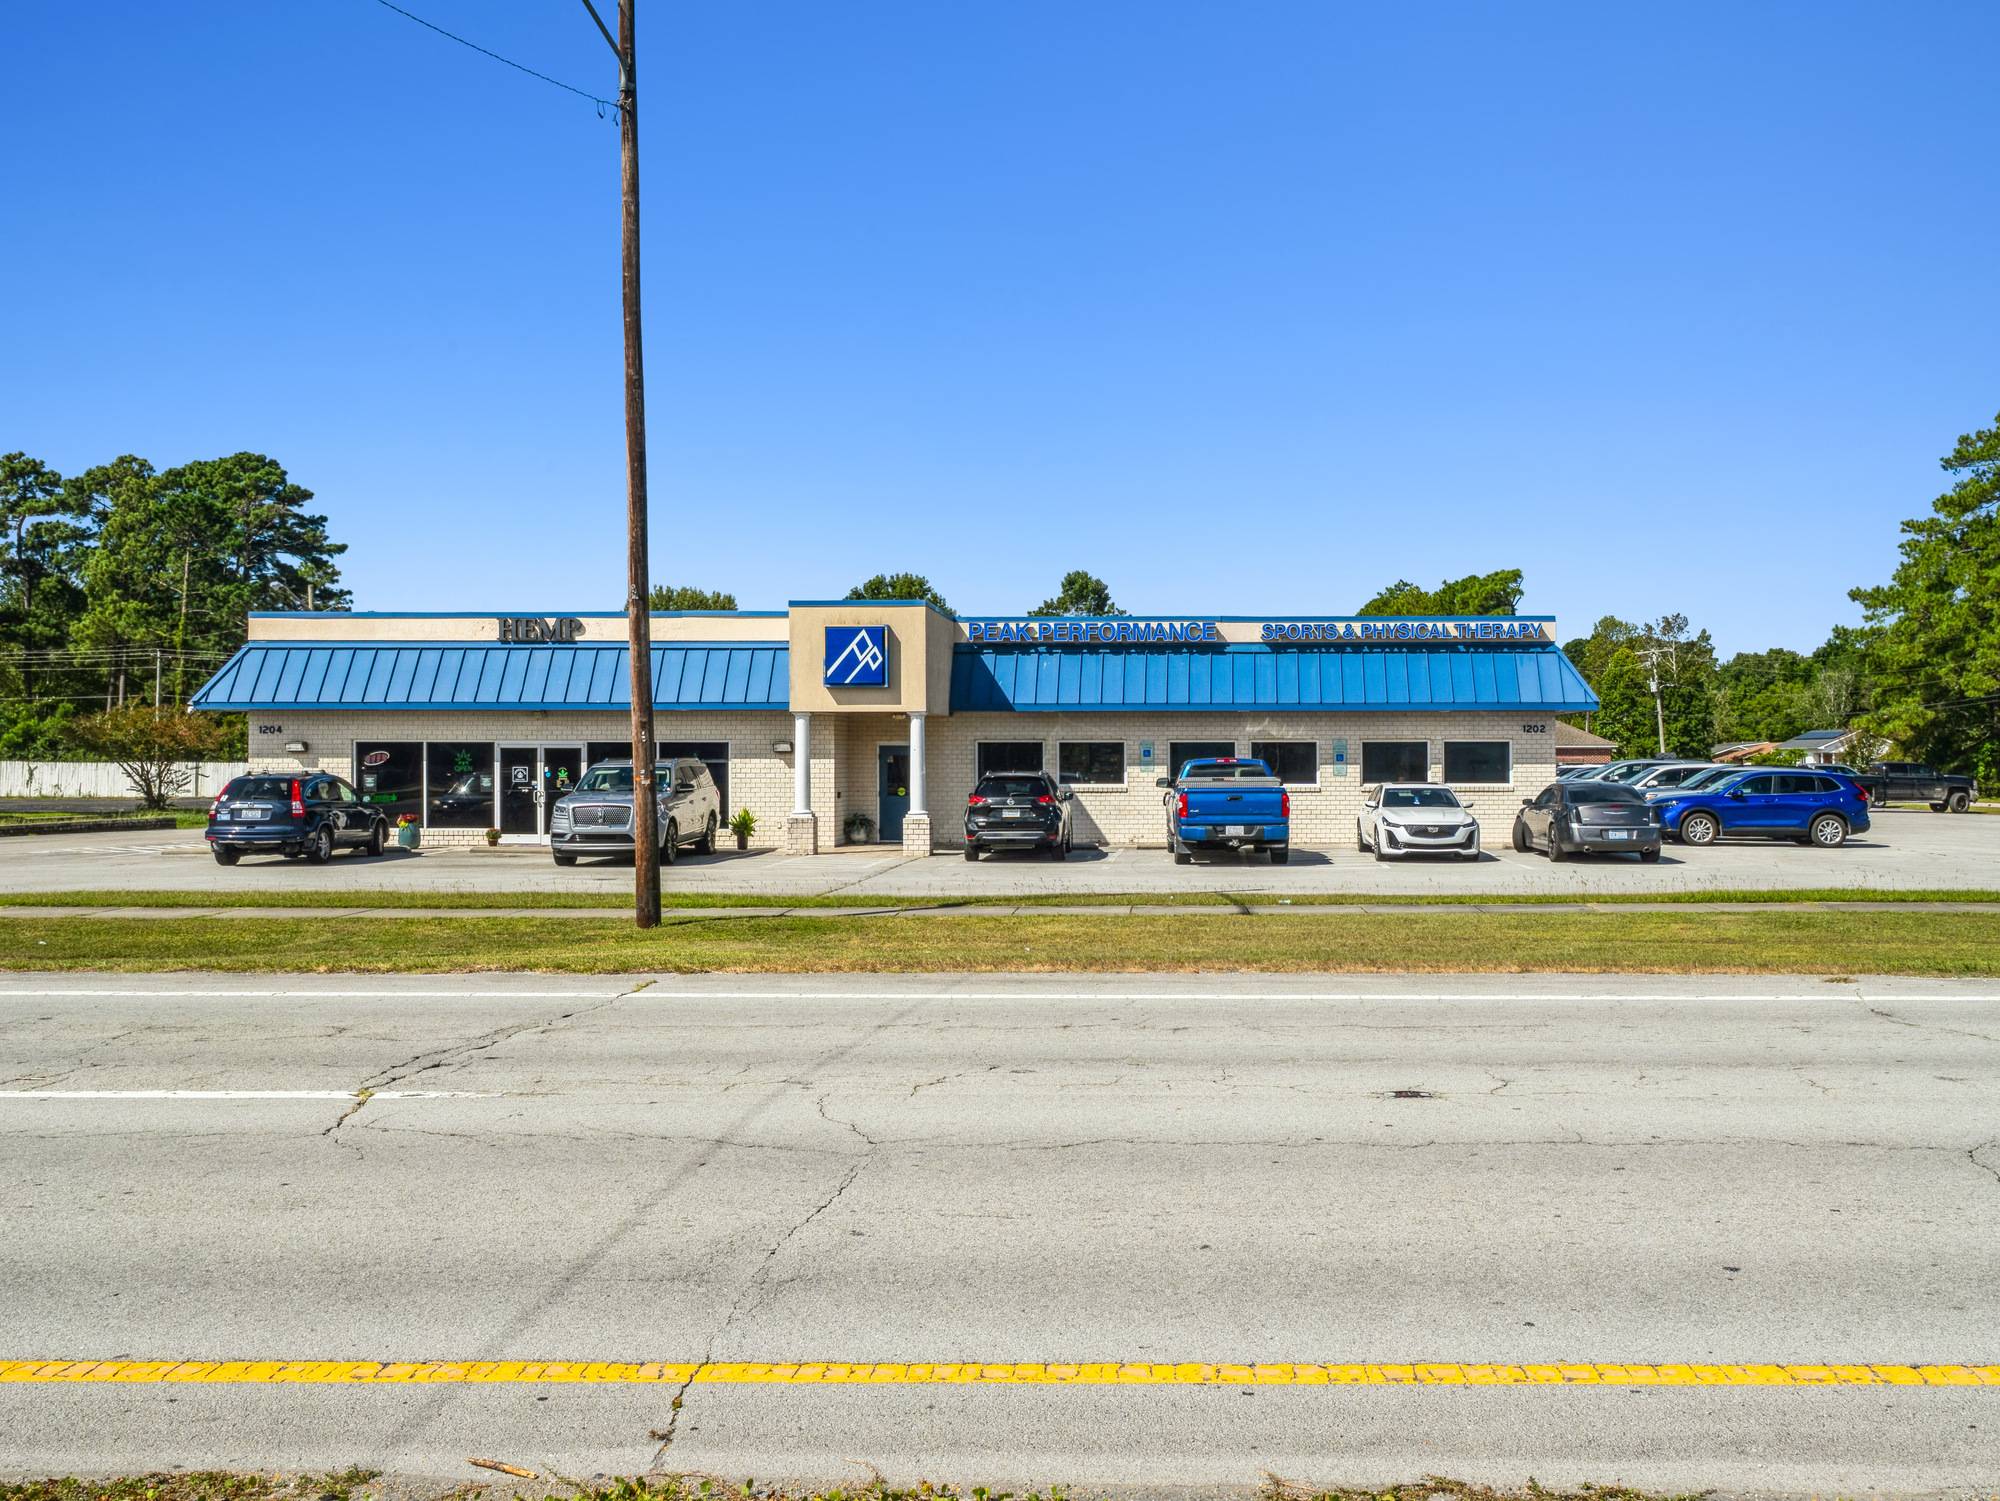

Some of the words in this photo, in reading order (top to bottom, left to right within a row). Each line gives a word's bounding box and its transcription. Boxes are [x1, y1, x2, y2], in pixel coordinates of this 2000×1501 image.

[497, 618, 586, 642] HEMP
[968, 622, 1031, 642] PEAK
[1038, 622, 1217, 642] PERFORMANCE
[1262, 623, 1341, 640] SPORTS
[1342, 623, 1355, 640] &
[1361, 623, 1452, 640] PHYSICAL
[1455, 623, 1543, 640] THERAPY
[259, 725, 282, 735] 1204
[1523, 724, 1546, 734] 1202
